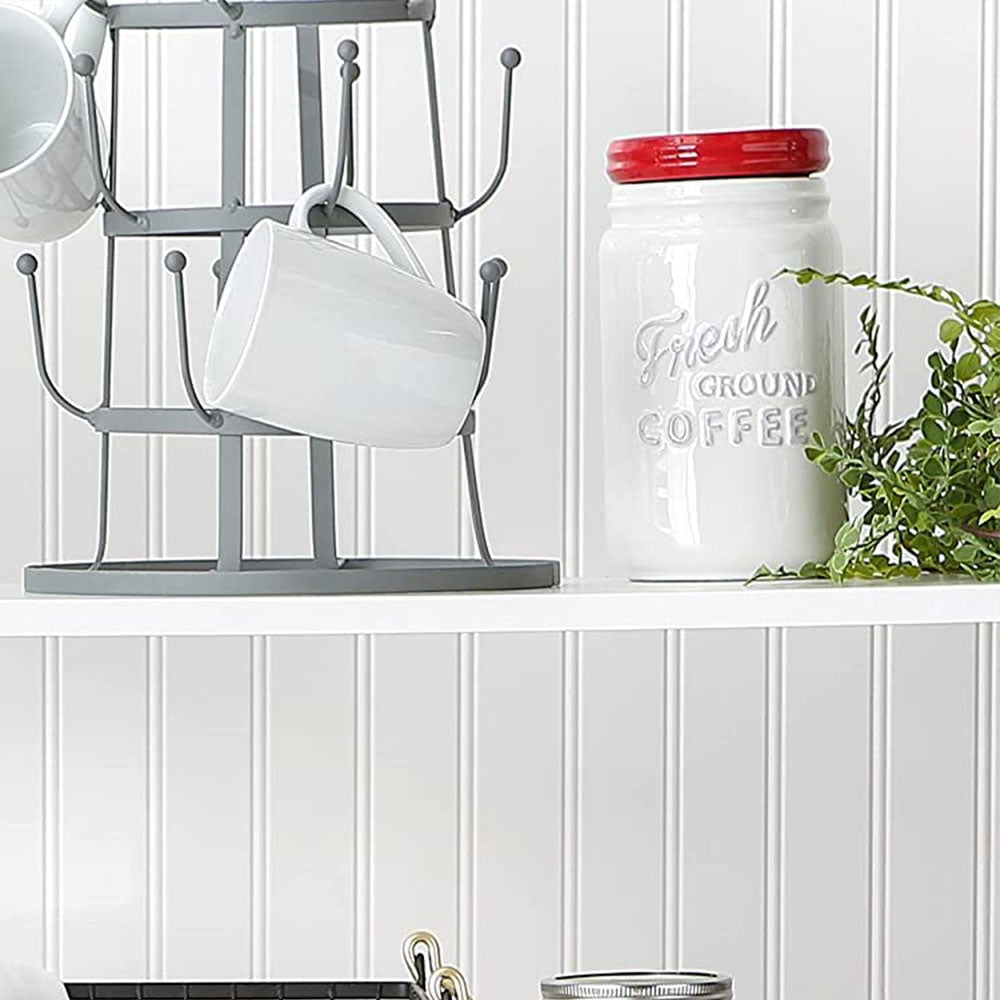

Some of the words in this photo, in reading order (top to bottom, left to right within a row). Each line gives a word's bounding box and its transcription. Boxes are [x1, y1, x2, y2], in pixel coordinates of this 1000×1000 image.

[635, 279, 777, 386] Fresh
[696, 371, 817, 399] GROUND
[637, 408, 811, 448] COFFEE
